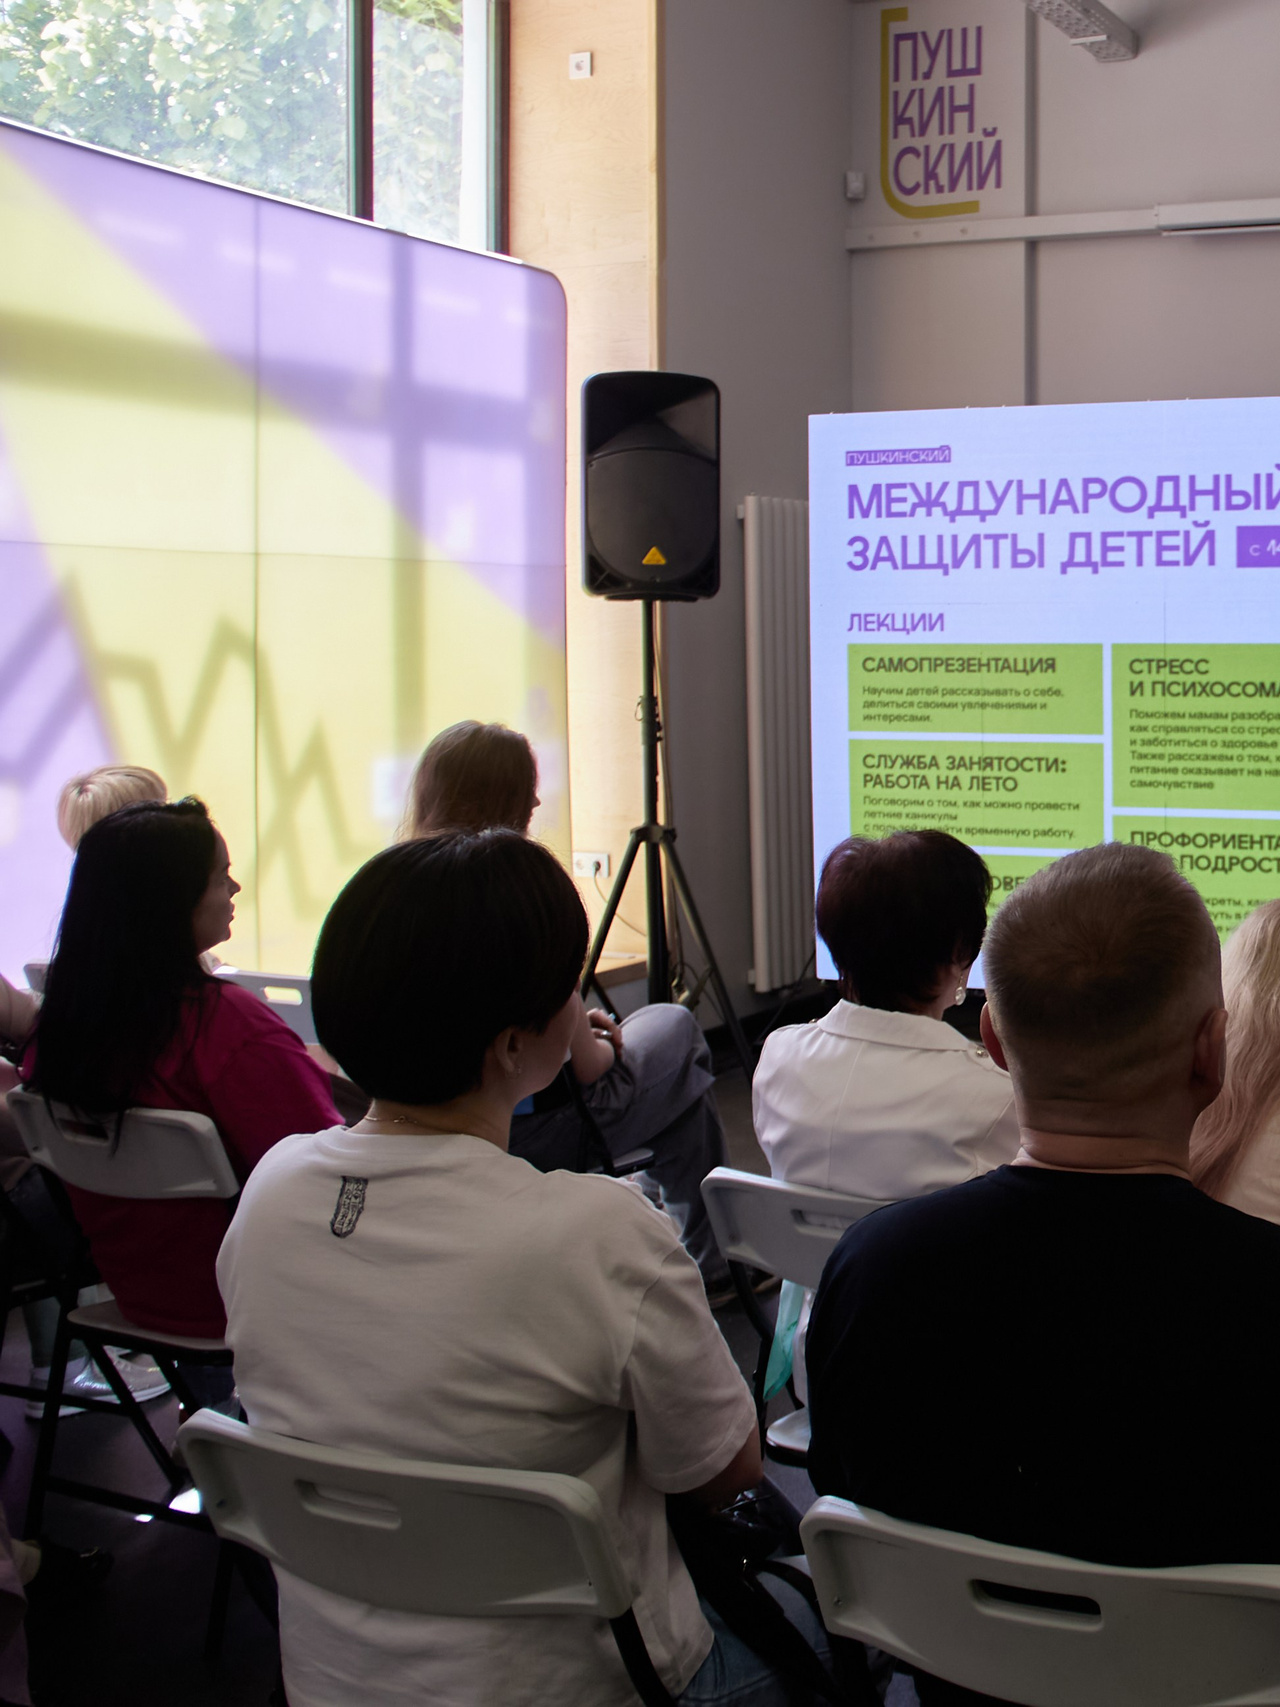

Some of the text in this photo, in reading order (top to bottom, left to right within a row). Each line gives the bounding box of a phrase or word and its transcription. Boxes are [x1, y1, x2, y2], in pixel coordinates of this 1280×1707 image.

[893, 25, 982, 82] ПУШ
[893, 83, 975, 139] КИН
[893, 127, 1002, 196] СКИЙ
[847, 446, 951, 465] ПУШКИНСКИЙ
[846, 521, 1216, 576] ЗАЩИТЫ ДЕТЕЙ
[1250, 545, 1260, 556] с
[847, 613, 945, 635] ЛЕКЦИИ
[862, 657, 1056, 675] САМОПРЕЗЕНТАЦИЯ
[1129, 658, 1209, 675] СТРЕСС
[863, 686, 1063, 698] Научим детей рассказывать о себе,
[1129, 681, 1143, 697] И
[863, 699, 1047, 712] делиться своими увлечениями и
[863, 713, 932, 724] интересами.
[1130, 709, 1186, 721] Поможем
[1188, 711, 1228, 721] мамам
[1130, 723, 1149, 733] как
[1151, 724, 1228, 735] справляться
[1231, 725, 1245, 734] со
[1130, 738, 1137, 746] и
[1139, 737, 1207, 748] заботиться
[1210, 739, 1218, 748] о
[862, 754, 1067, 773] СЛУЖБА ЗАНЯТОСТИ:
[1130, 750, 1165, 761] Также
[1168, 752, 1233, 763] расскажем
[1236, 754, 1244, 762] о
[1130, 766, 1178, 776] питание
[1181, 767, 1244, 776] оказывает
[1247, 768, 1262, 777] на
[862, 774, 1018, 792] РАБОТА НА ЛЕТО
[1130, 779, 1214, 790] самочувствие
[863, 796, 925, 809] Поговорим
[927, 799, 934, 807] о
[963, 800, 981, 808] как
[984, 800, 1022, 810] можно
[1025, 801, 1080, 812] провести
[863, 810, 957, 824] летние каникулы
[965, 825, 1031, 838] временную
[1033, 827, 1075, 840] работу.
[1204, 897, 1243, 908] креты,
